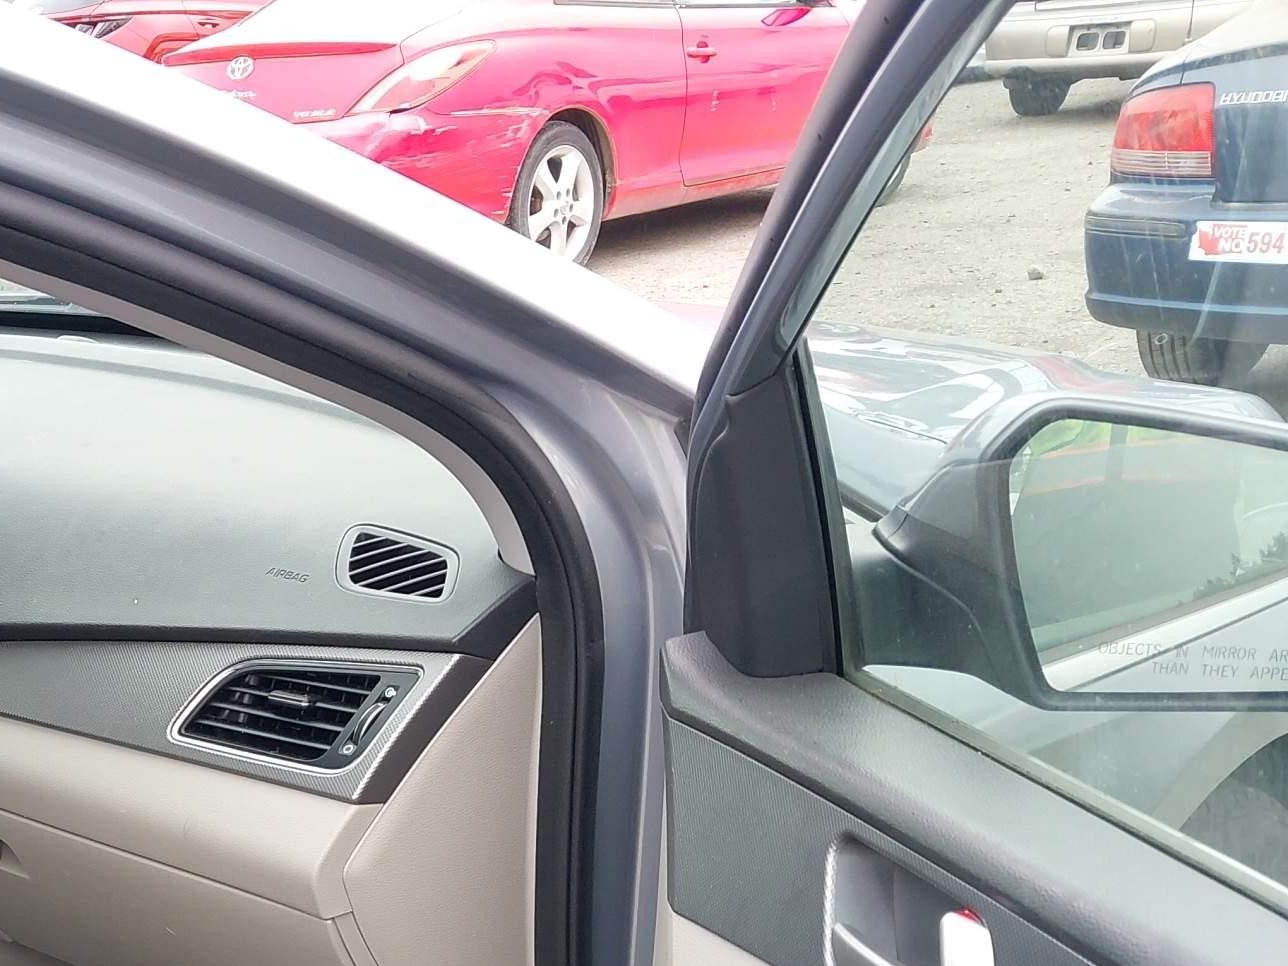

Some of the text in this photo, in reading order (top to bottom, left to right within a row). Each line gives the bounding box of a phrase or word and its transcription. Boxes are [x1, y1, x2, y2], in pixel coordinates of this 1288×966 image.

[1213, 226, 1246, 239] VOTE
[1247, 231, 1286, 254] 594
[265, 567, 310, 583] AIRBAG
[1098, 641, 1162, 657] OBJECTS
[1175, 646, 1189, 658] IN
[1201, 645, 1257, 661] MIRROR
[1151, 661, 1189, 675] THAN
[1201, 663, 1239, 679] THEY
